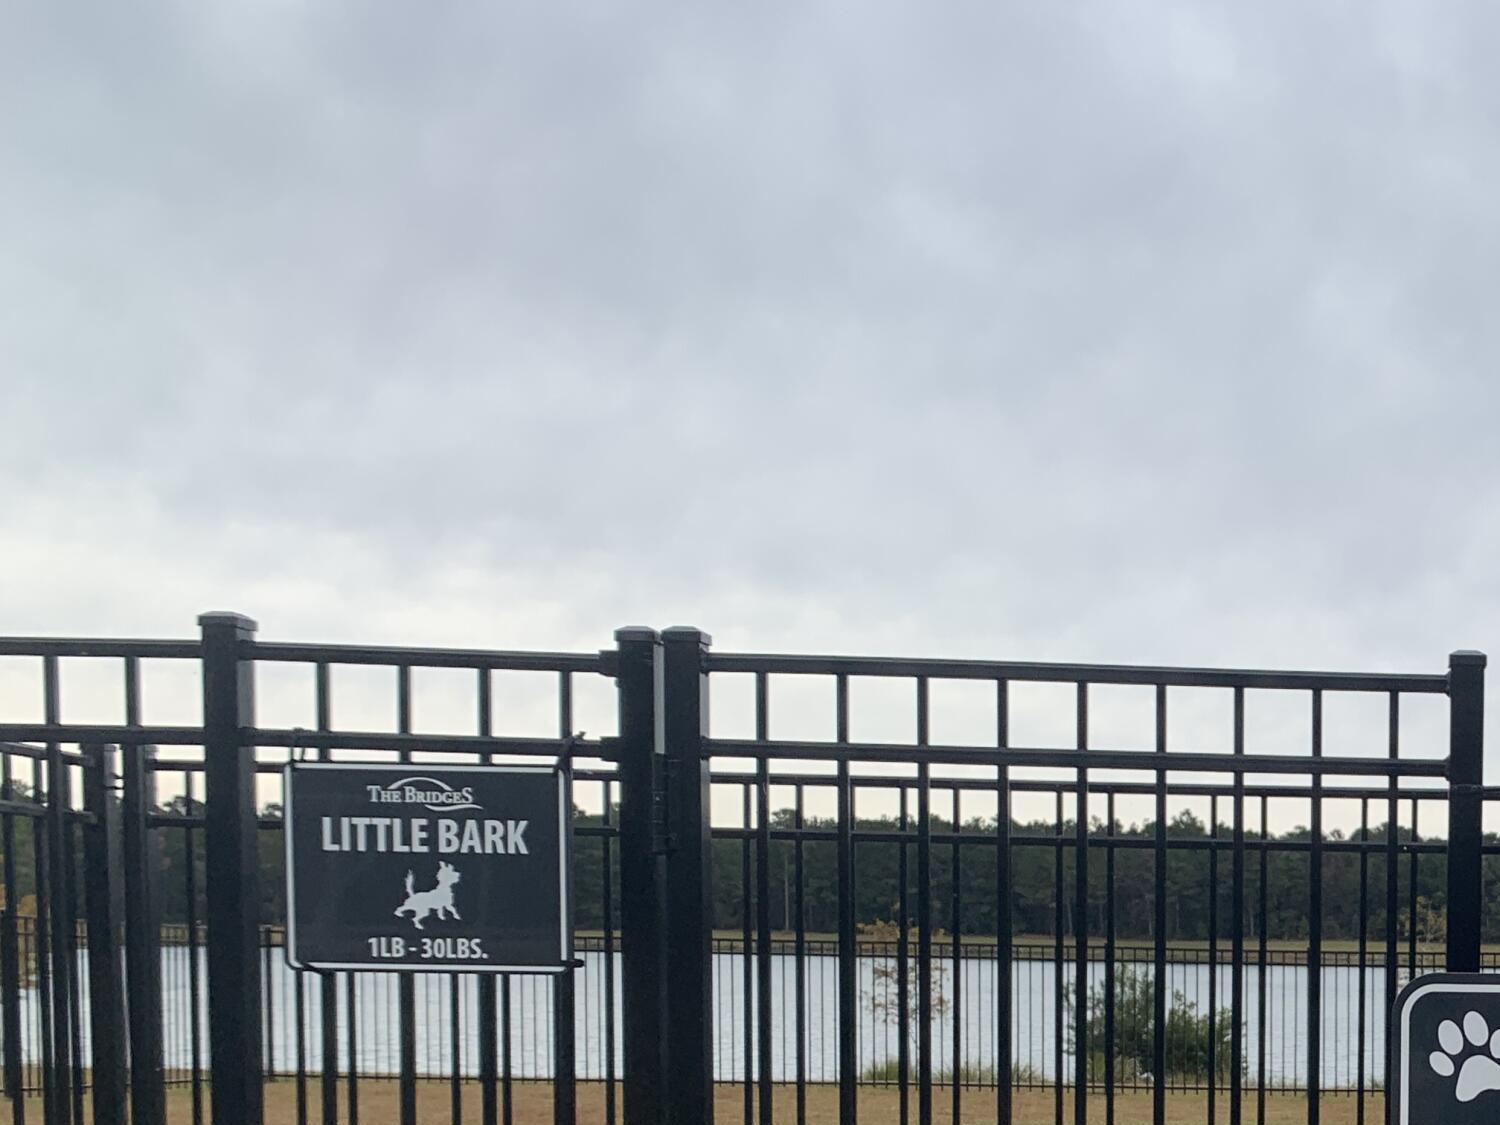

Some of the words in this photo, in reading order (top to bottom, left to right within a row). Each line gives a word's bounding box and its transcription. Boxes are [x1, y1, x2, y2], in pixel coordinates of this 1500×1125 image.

[322, 816, 429, 853] LITTLE
[437, 818, 529, 855] BARK
[367, 936, 405, 958] 1LB
[420, 937, 488, 959] 30LBS.
